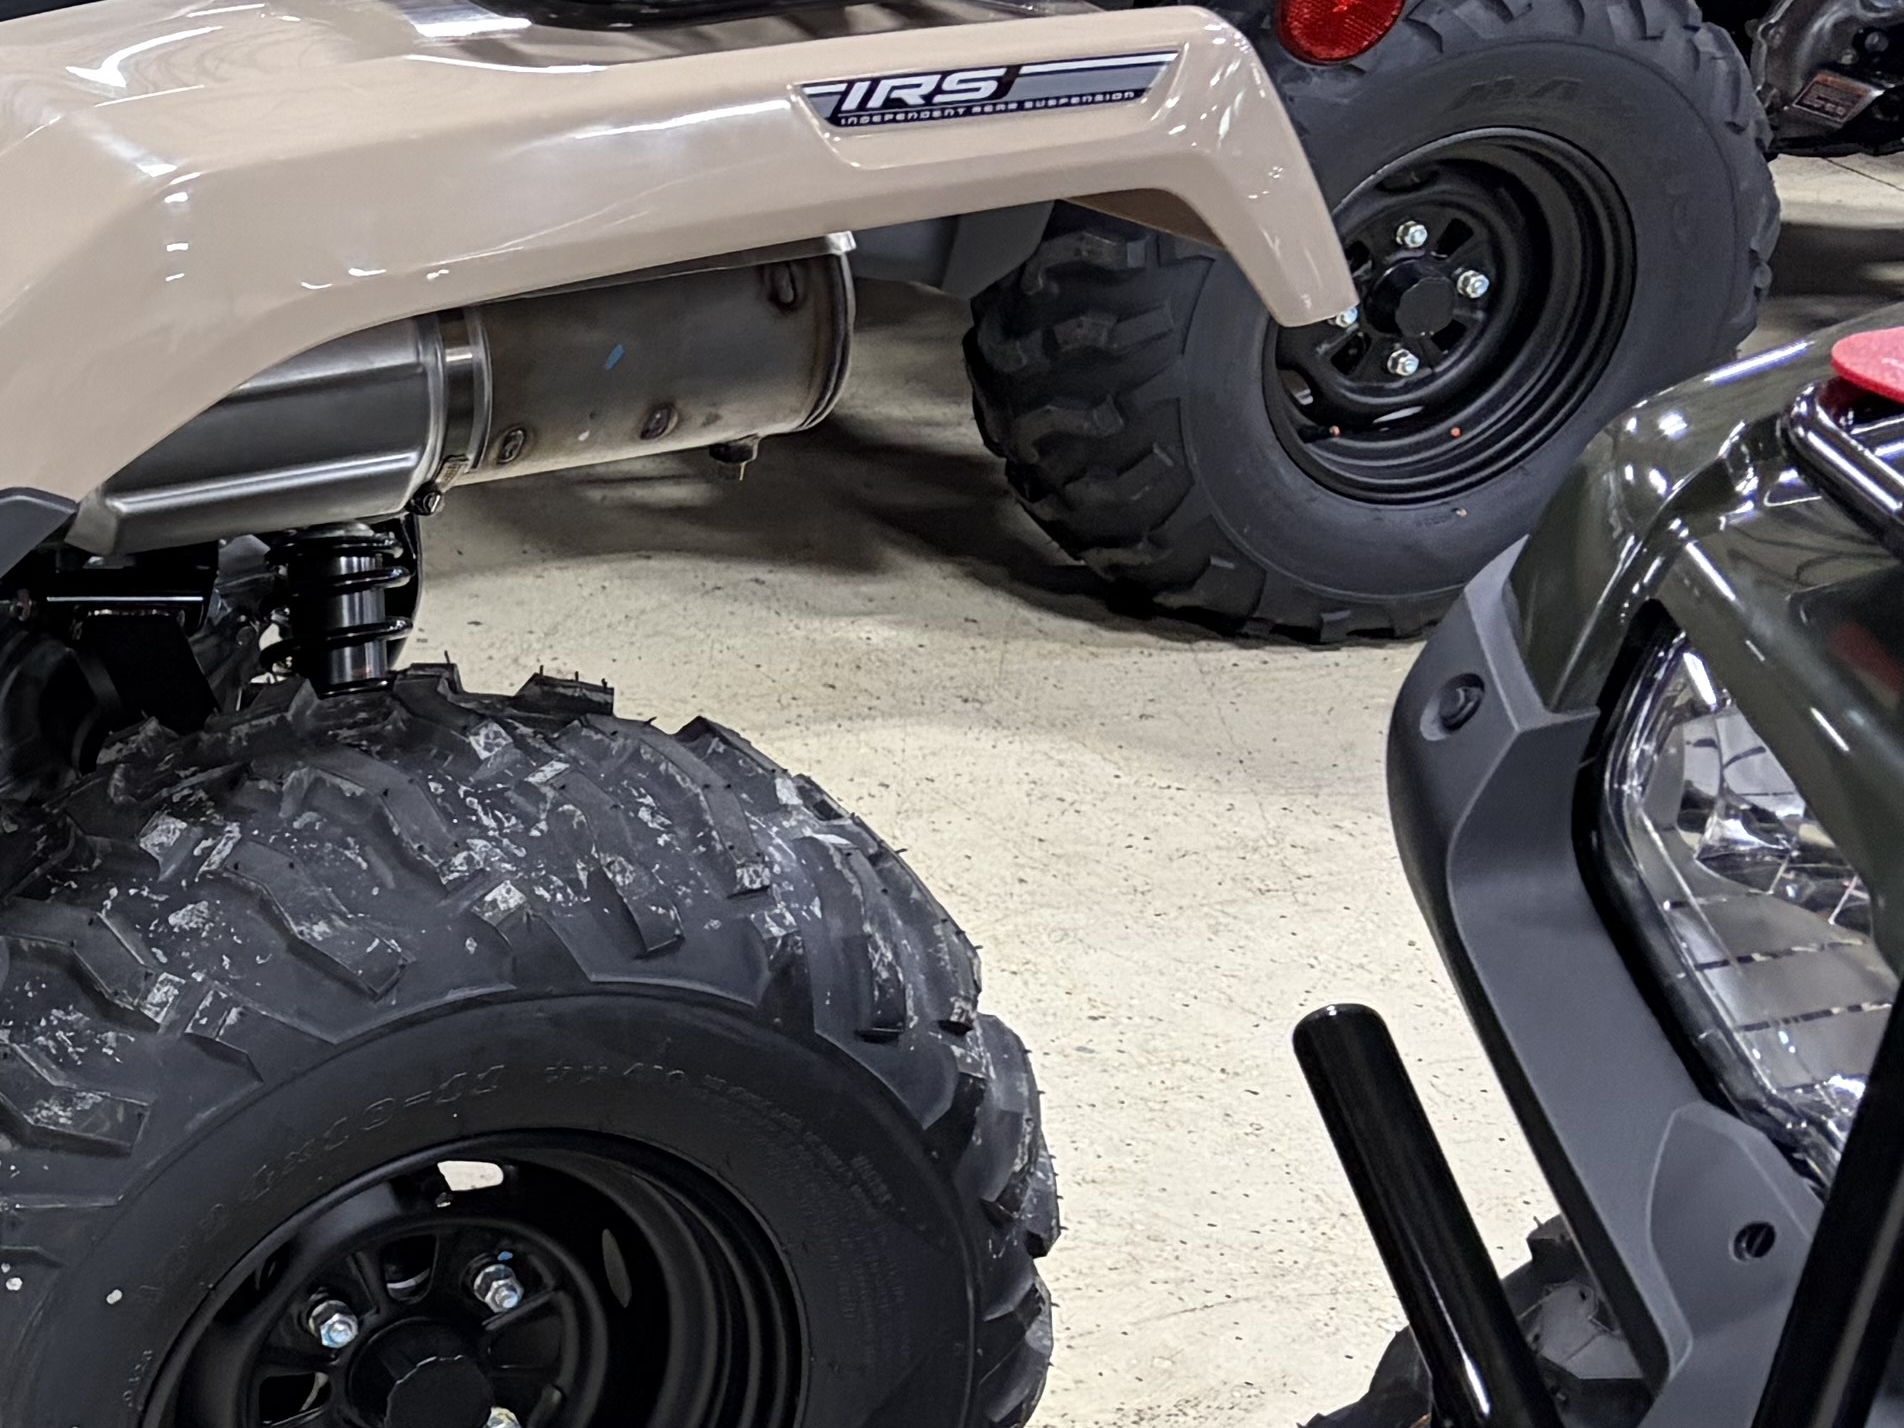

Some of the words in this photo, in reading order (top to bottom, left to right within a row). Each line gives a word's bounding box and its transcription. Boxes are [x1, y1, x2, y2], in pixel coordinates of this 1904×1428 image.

[841, 68, 1007, 111] IRS
[841, 106, 967, 126] INDEPENDENT
[972, 100, 1018, 114] REAR
[1024, 90, 1136, 110] SUSPENSION
